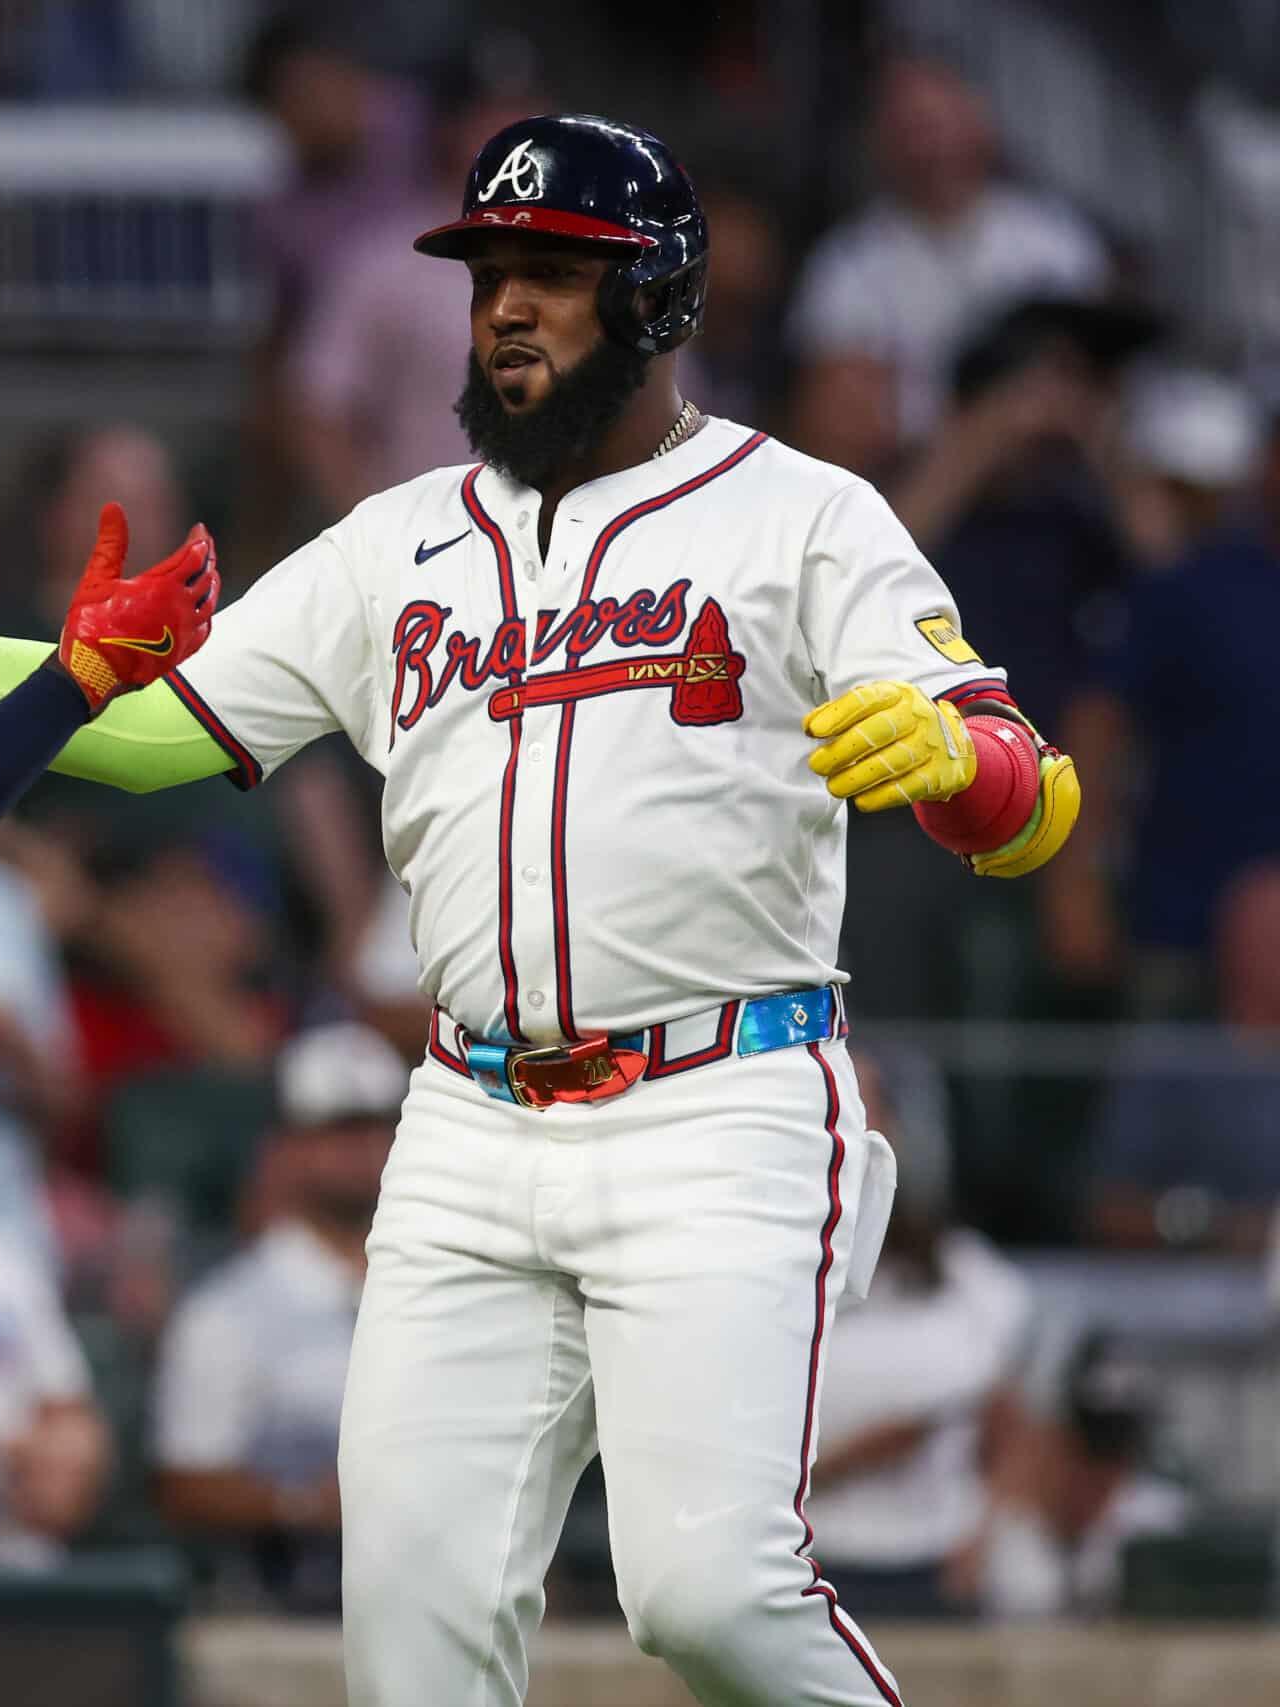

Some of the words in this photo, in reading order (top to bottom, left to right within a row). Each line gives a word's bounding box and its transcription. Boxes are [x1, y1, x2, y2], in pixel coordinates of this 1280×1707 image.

[478, 138, 539, 202] A
[388, 577, 692, 753] Braves
[584, 1056, 613, 1086] 20
